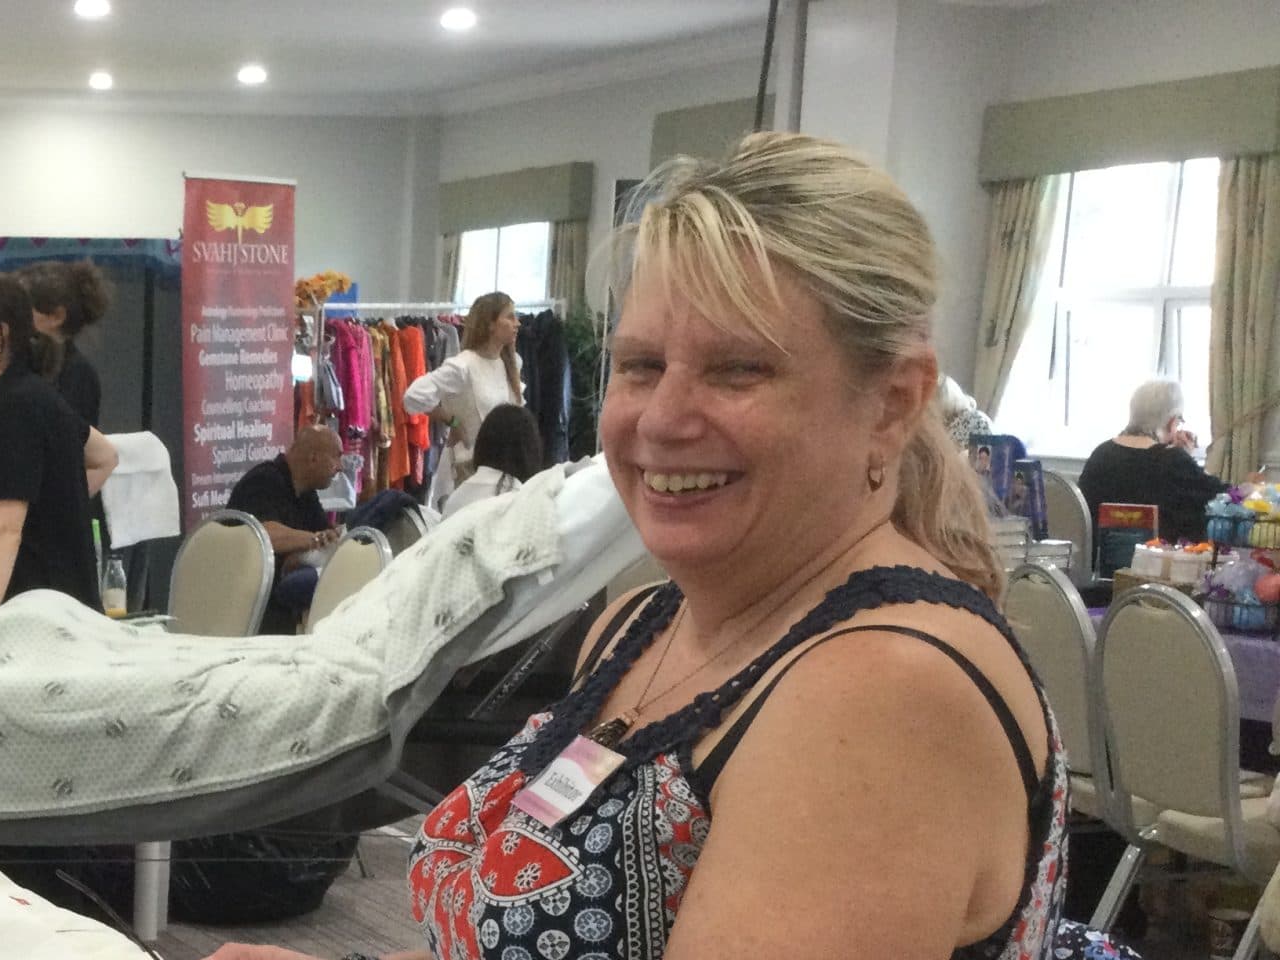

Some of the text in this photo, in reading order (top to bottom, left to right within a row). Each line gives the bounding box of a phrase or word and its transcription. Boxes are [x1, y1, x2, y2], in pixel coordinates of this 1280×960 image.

[239, 243, 289, 265] STONE
[211, 323, 266, 348] Management
[224, 369, 285, 394] Homeopathy
[193, 420, 273, 446] Spiritual Healing
[212, 443, 247, 468] Spiritual
